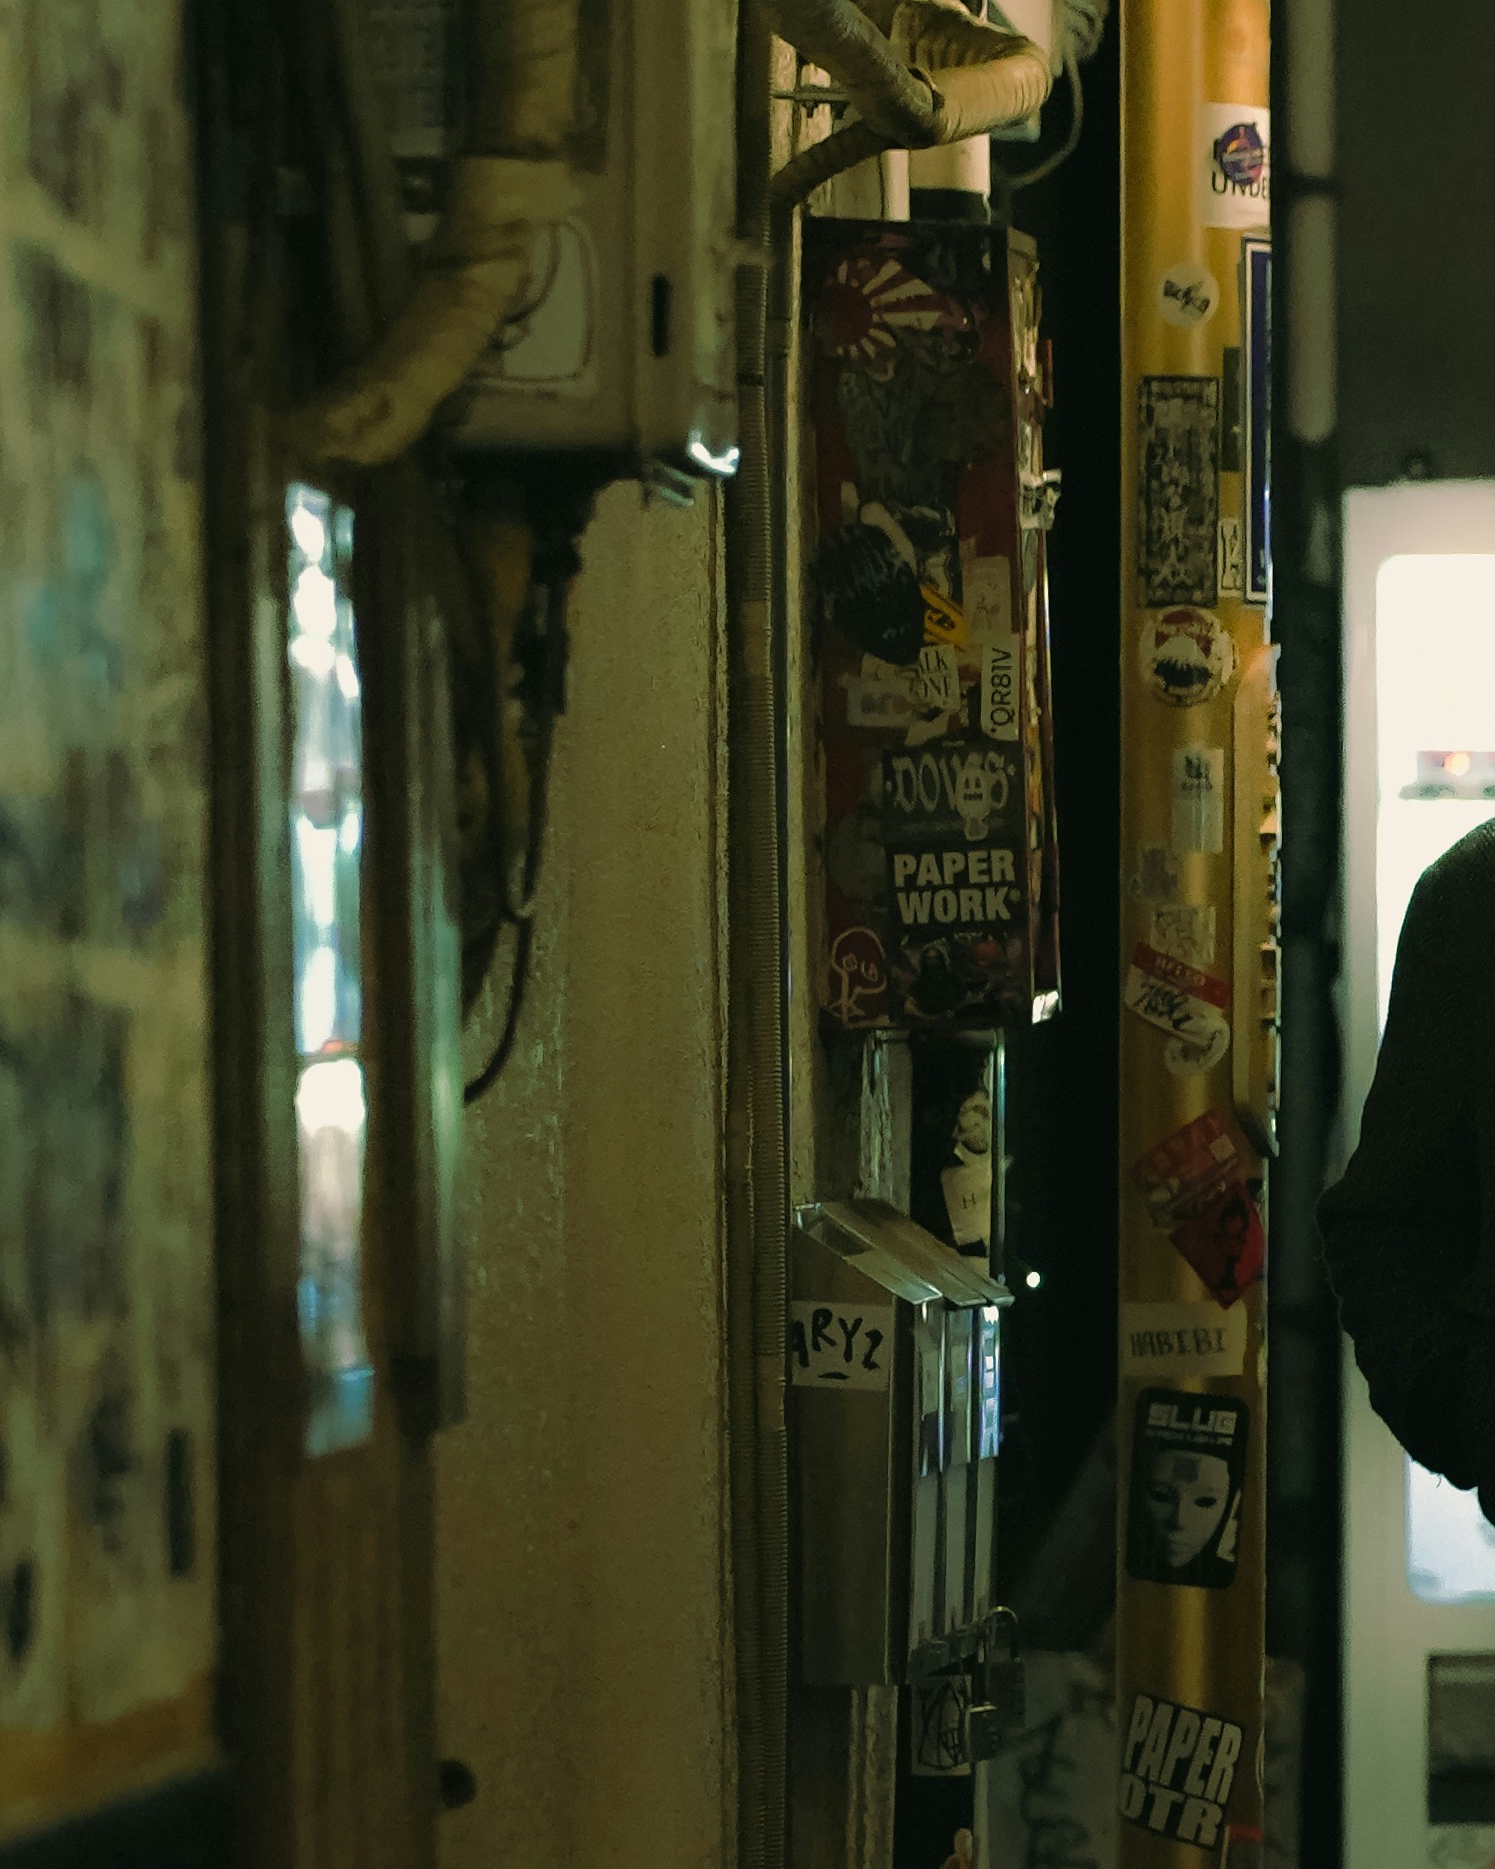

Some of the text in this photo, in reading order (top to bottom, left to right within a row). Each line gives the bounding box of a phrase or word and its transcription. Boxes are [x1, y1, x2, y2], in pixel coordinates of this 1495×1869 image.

[893, 848, 1016, 888] PAPER
[896, 886, 1012, 927] WORK
[1124, 1694, 1243, 1804] PAPER
